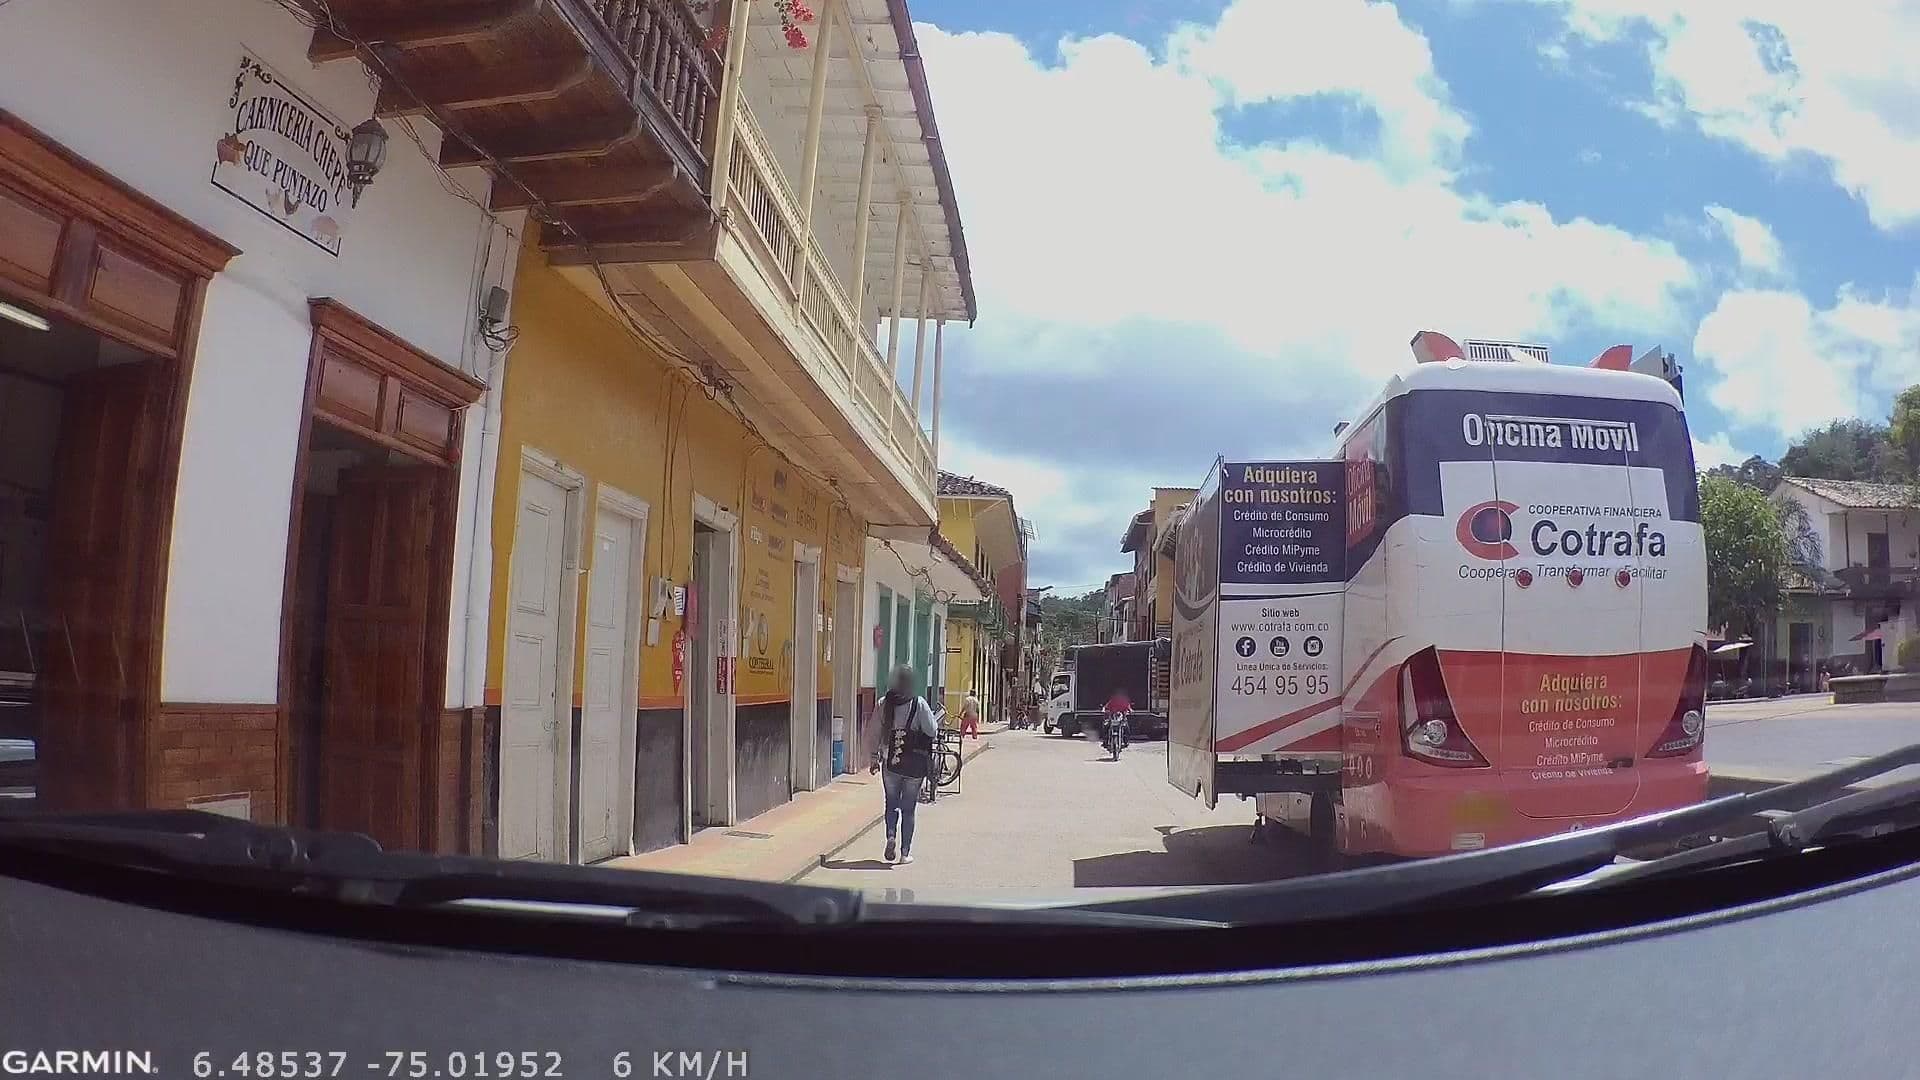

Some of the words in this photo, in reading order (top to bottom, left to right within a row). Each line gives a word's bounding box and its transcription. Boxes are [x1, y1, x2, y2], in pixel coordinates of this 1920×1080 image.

[236, 96, 314, 152] CARNICERIA
[244, 140, 272, 177] QUE
[272, 158, 328, 213] PUNTAZO
[1243, 466, 1318, 487] Adquiera
[1224, 488, 1255, 504] con
[1260, 487, 1338, 505] nosotros:
[1233, 509, 1269, 522] Crédito
[1271, 510, 1283, 522] de
[1285, 509, 1329, 522] Consumo
[1527, 504, 1602, 517] COOPERATIVA
[1603, 506, 1663, 519] FINANCIERA
[1252, 527, 1312, 539] Microcrédito
[1530, 519, 1667, 557] Cotrafa
[1245, 544, 1280, 556] Crédito
[1237, 561, 1272, 574] Crédito
[1274, 561, 1287, 573] de
[1289, 561, 1329, 573] Vivienda
[1261, 607, 1281, 618] Sitio
[1282, 607, 1300, 618] web
[1231, 675, 1267, 696] 454
[1275, 675, 1298, 695] 95
[1306, 674, 1329, 695] 95
[1540, 673, 1608, 694] Adquiera
[1521, 698, 1549, 714] con
[1554, 693, 1622, 713] nosotros:
[1562, 718, 1573, 730] de
[1575, 717, 1615, 729] Consumo
